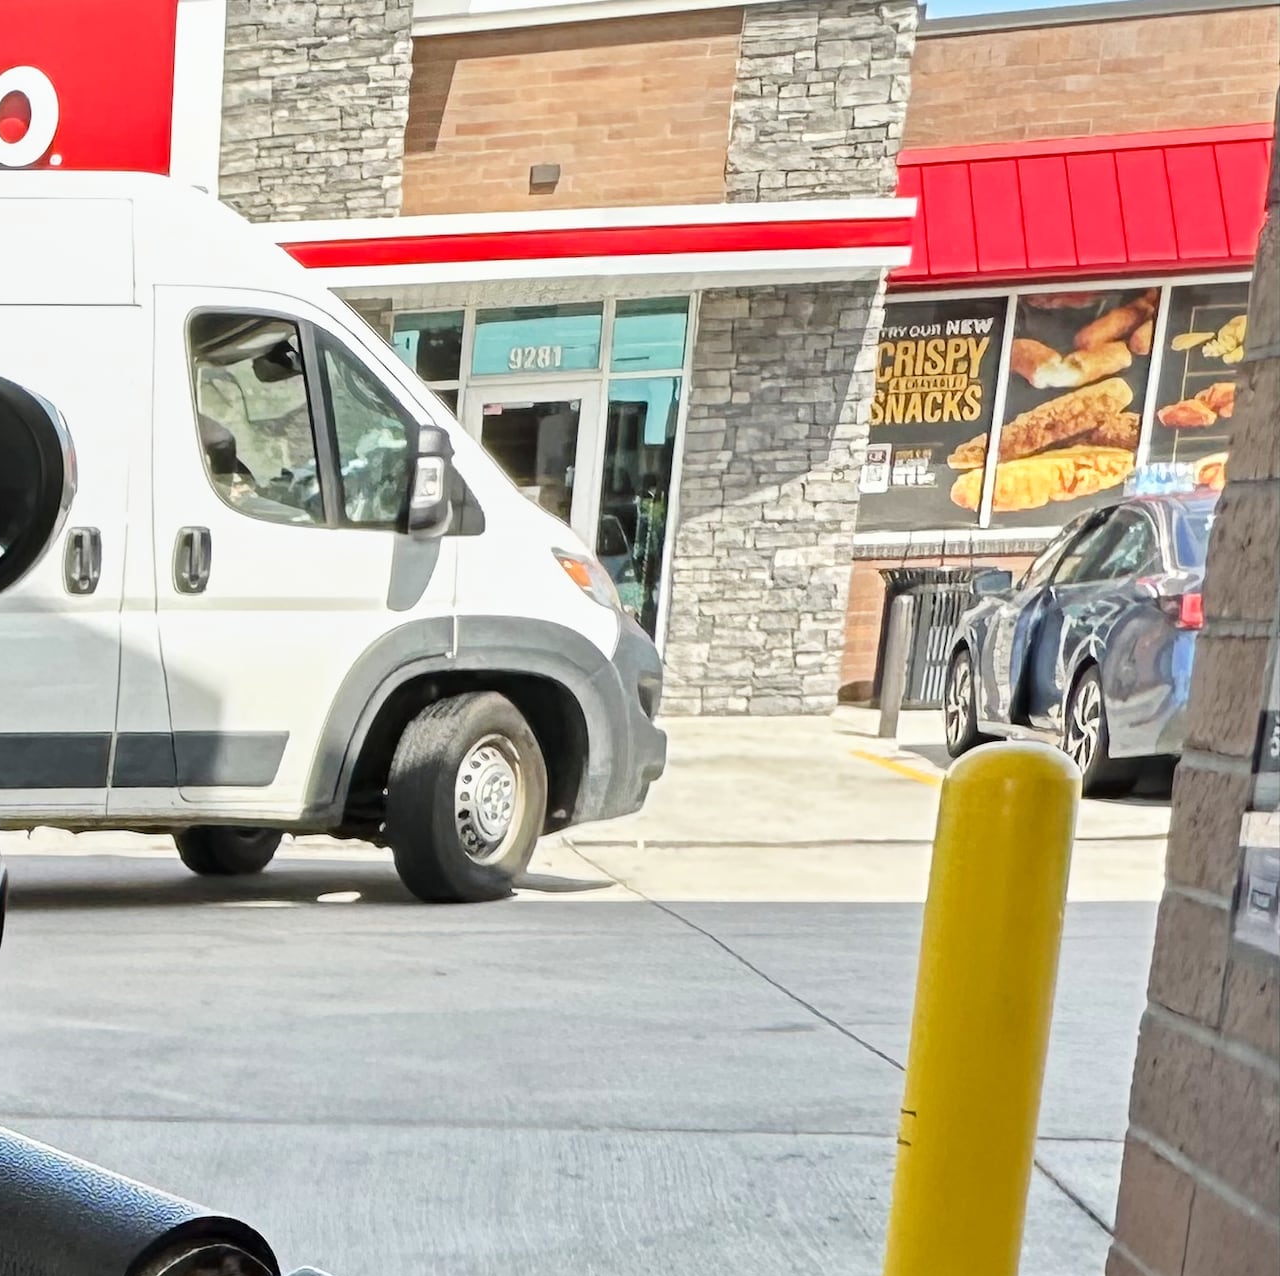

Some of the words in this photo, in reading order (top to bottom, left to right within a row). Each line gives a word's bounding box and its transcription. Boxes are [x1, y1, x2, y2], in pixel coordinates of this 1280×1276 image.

[909, 324, 941, 337] OUR
[946, 317, 994, 335] NEW
[508, 345, 562, 370] 9281
[877, 338, 989, 383] CRISPY
[870, 386, 982, 425] SNACKS
